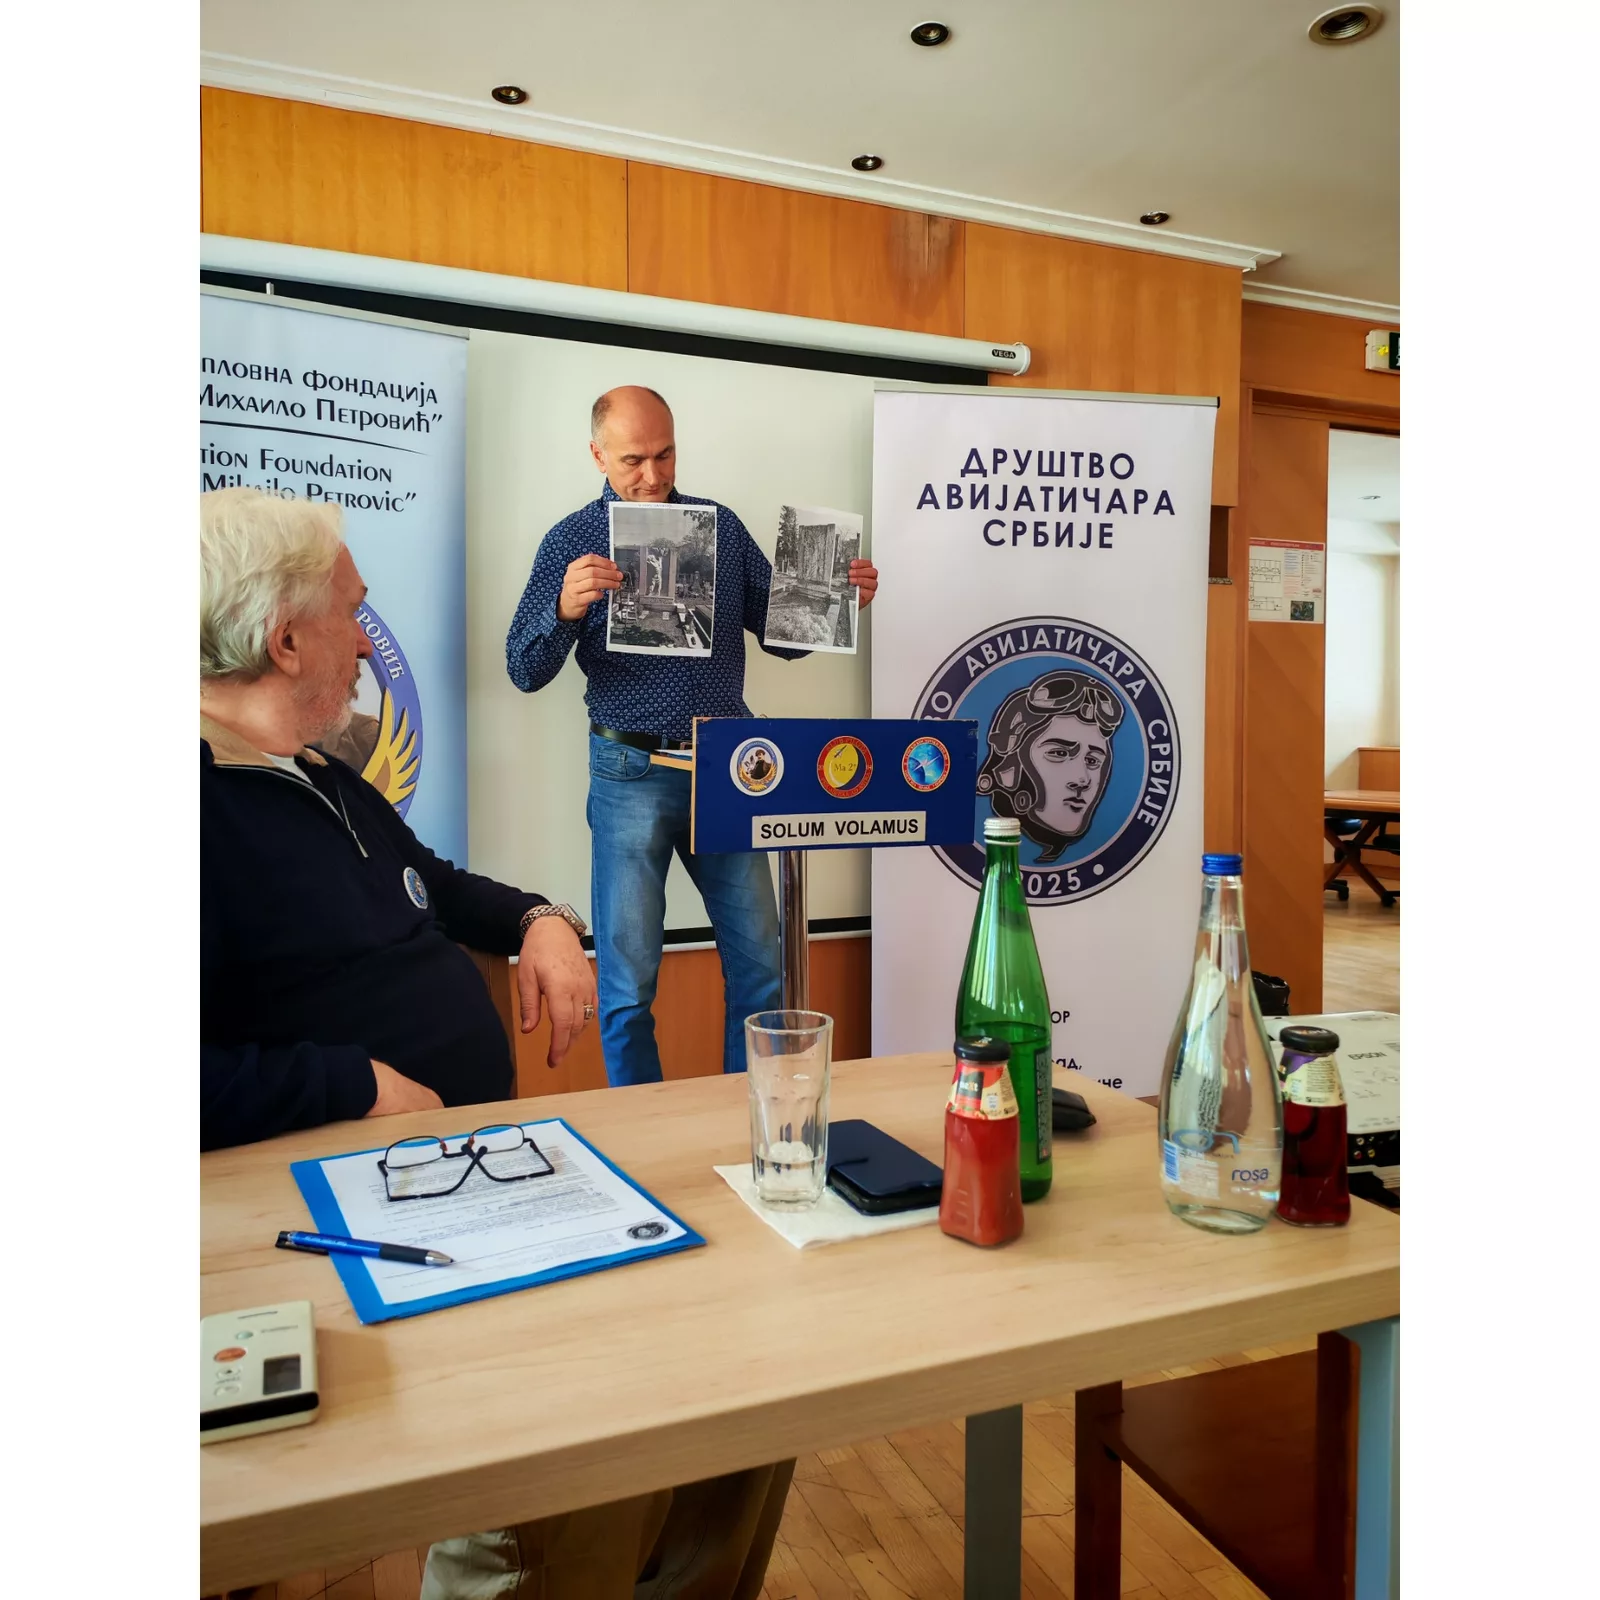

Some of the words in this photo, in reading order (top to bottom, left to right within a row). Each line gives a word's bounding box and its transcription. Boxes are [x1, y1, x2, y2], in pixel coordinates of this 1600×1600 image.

[993, 350, 1015, 358] VEGA
[302, 370, 438, 407] фондација
[960, 448, 1135, 480] ДРУШТВО
[916, 483, 1176, 516] АВИЈАТИЧАРА
[983, 519, 1113, 549] СРБИЈЕ
[356, 607, 404, 681] РОВИЋ
[965, 628, 1147, 700] АВИЈАТИЧАРА
[1137, 719, 1171, 827] СРБИЈЕ
[760, 821, 825, 839] SOLUM
[835, 818, 919, 836] VOLAMUS
[1231, 1168, 1269, 1182] rosa
